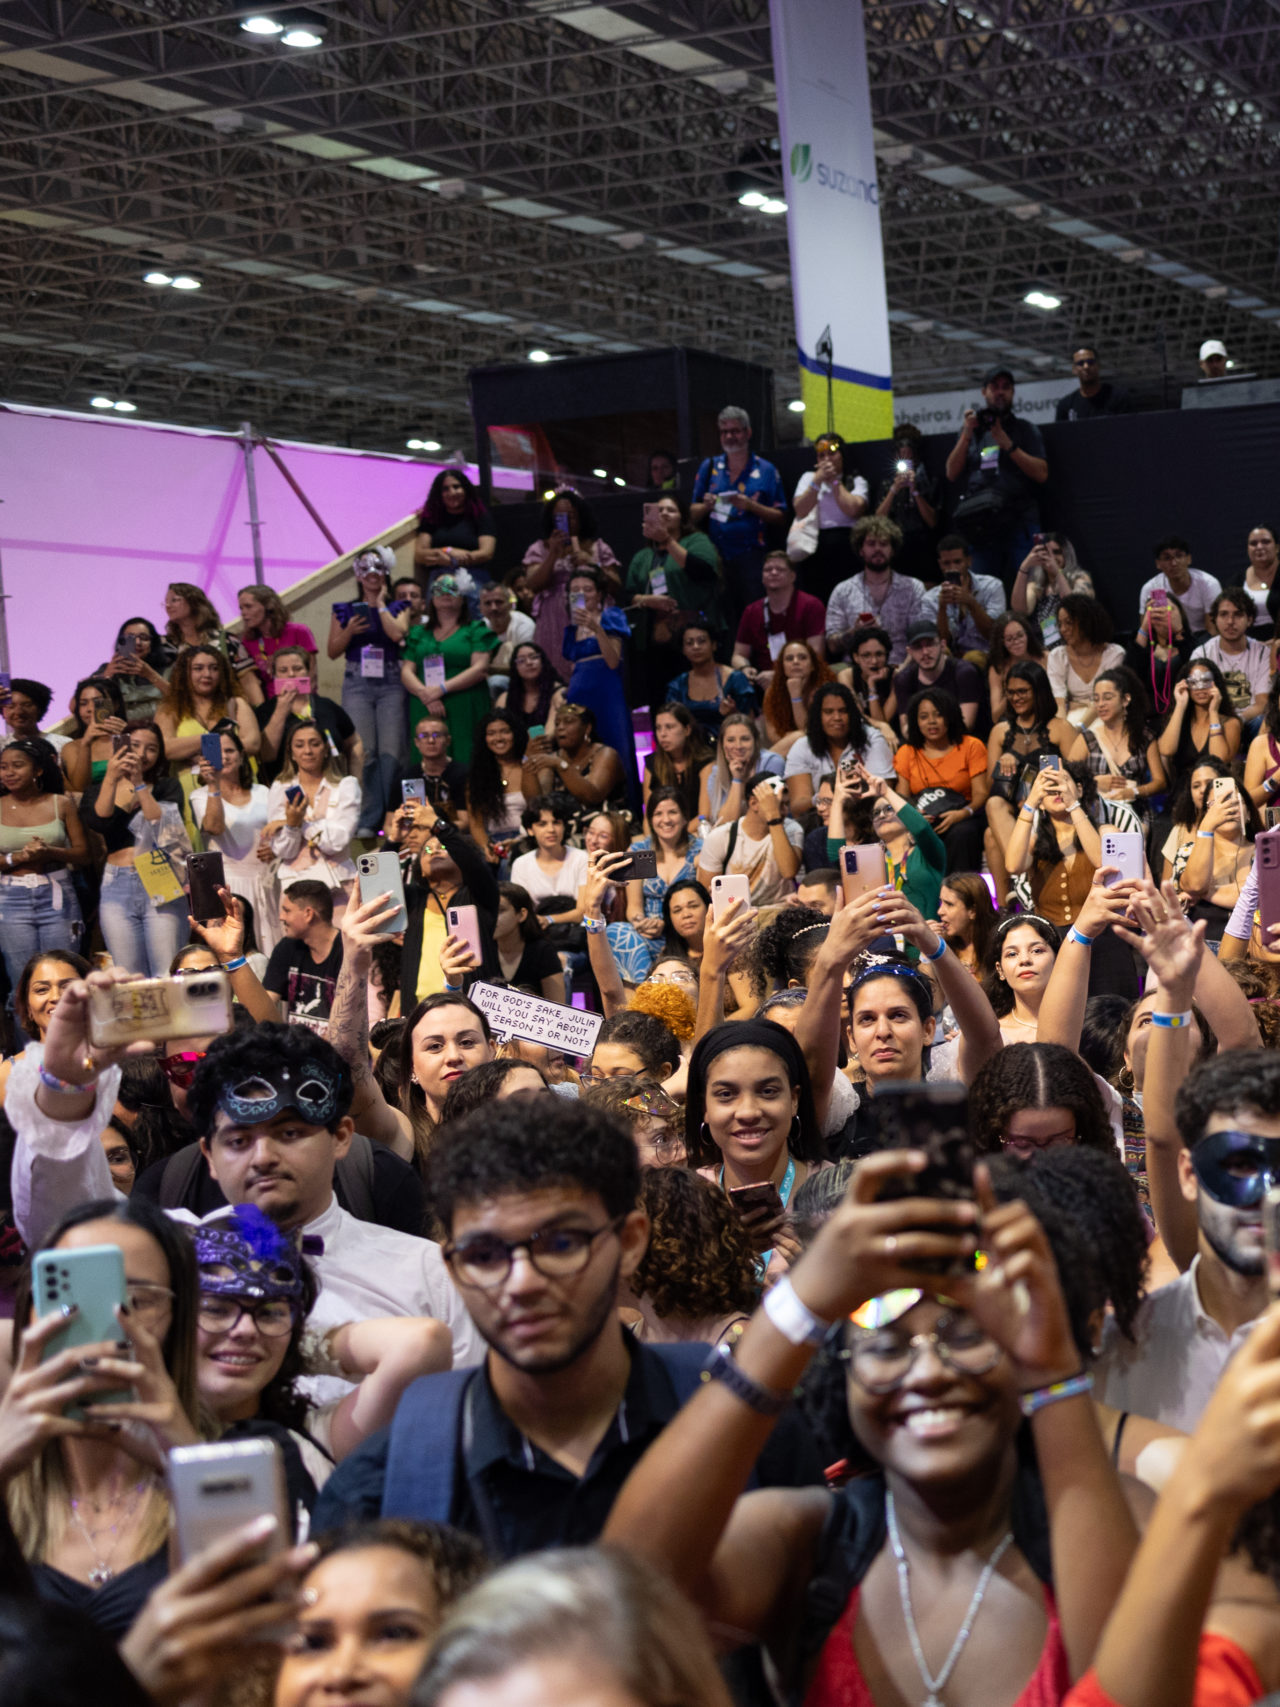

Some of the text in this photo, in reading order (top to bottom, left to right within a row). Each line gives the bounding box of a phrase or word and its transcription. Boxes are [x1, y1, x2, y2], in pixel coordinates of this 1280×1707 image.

[479, 988, 596, 1027] FOR GOD'S SAKE, JULIA
[481, 999, 588, 1036] WILL YOU SAY ABOUT
[493, 1014, 534, 1032] SEASON
[536, 1026, 543, 1035] 3
[547, 1030, 561, 1041] OR
[564, 1034, 590, 1048] NOT?
